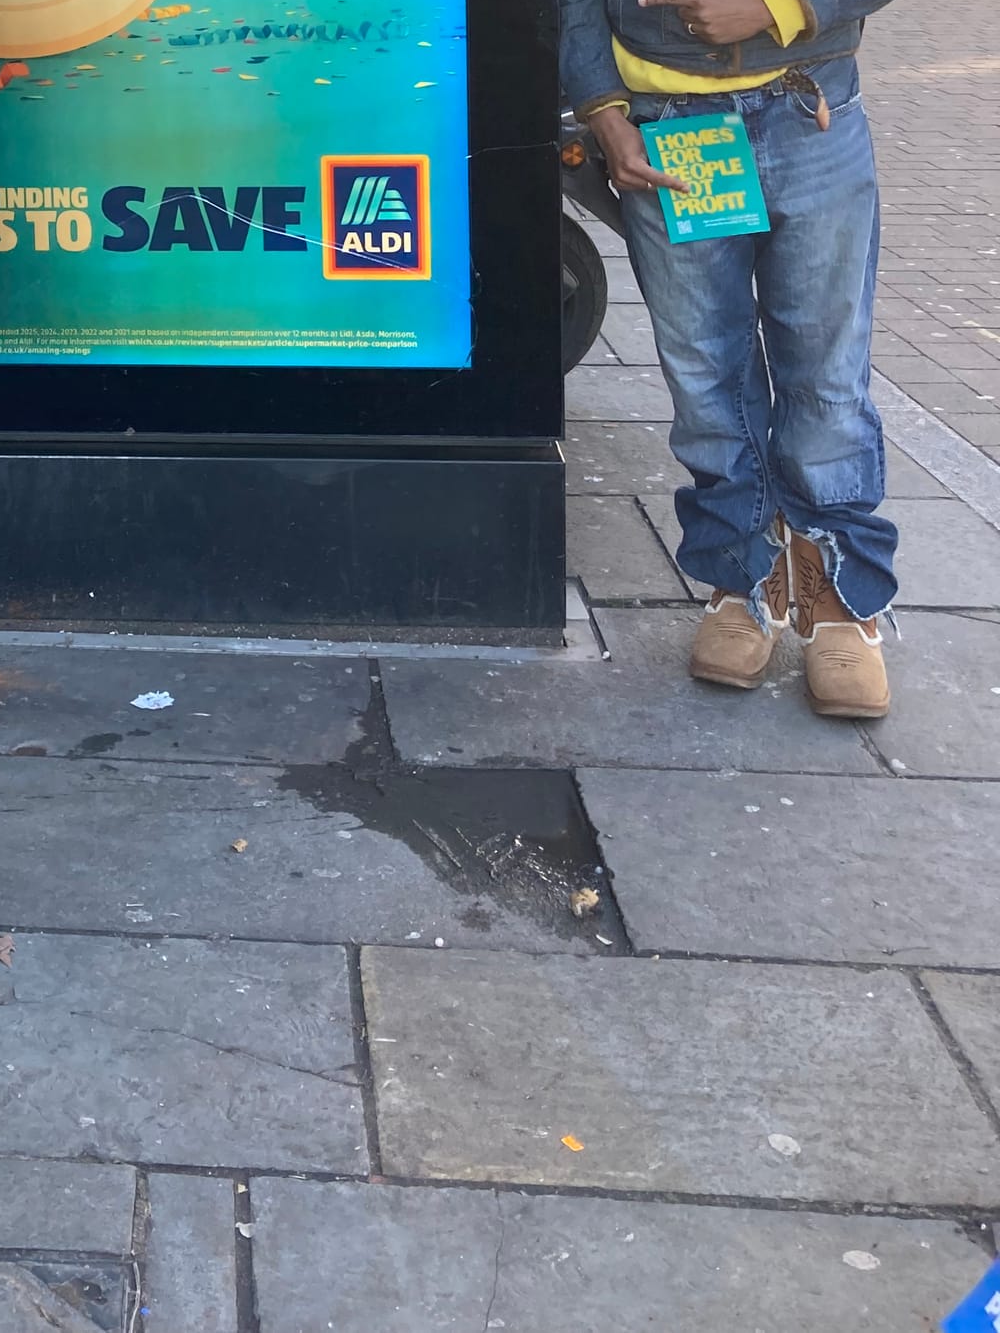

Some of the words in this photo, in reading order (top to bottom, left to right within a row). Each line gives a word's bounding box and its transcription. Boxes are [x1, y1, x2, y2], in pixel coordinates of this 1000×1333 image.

[655, 127, 736, 152] HOMES
[660, 147, 704, 168] FOR
[663, 157, 744, 184] PEOPLE
[673, 191, 747, 217] PROFIT
[25, 210, 93, 253] TO
[101, 185, 309, 253] SAVE
[340, 232, 413, 253] ALDI
[69, 338, 112, 346] information
[147, 329, 169, 337] based
[181, 329, 229, 338] independent
[230, 330, 273, 339] comparison
[301, 330, 329, 338] months
[355, 330, 377, 339] Asda,
[378, 330, 417, 339] Morrisons,
